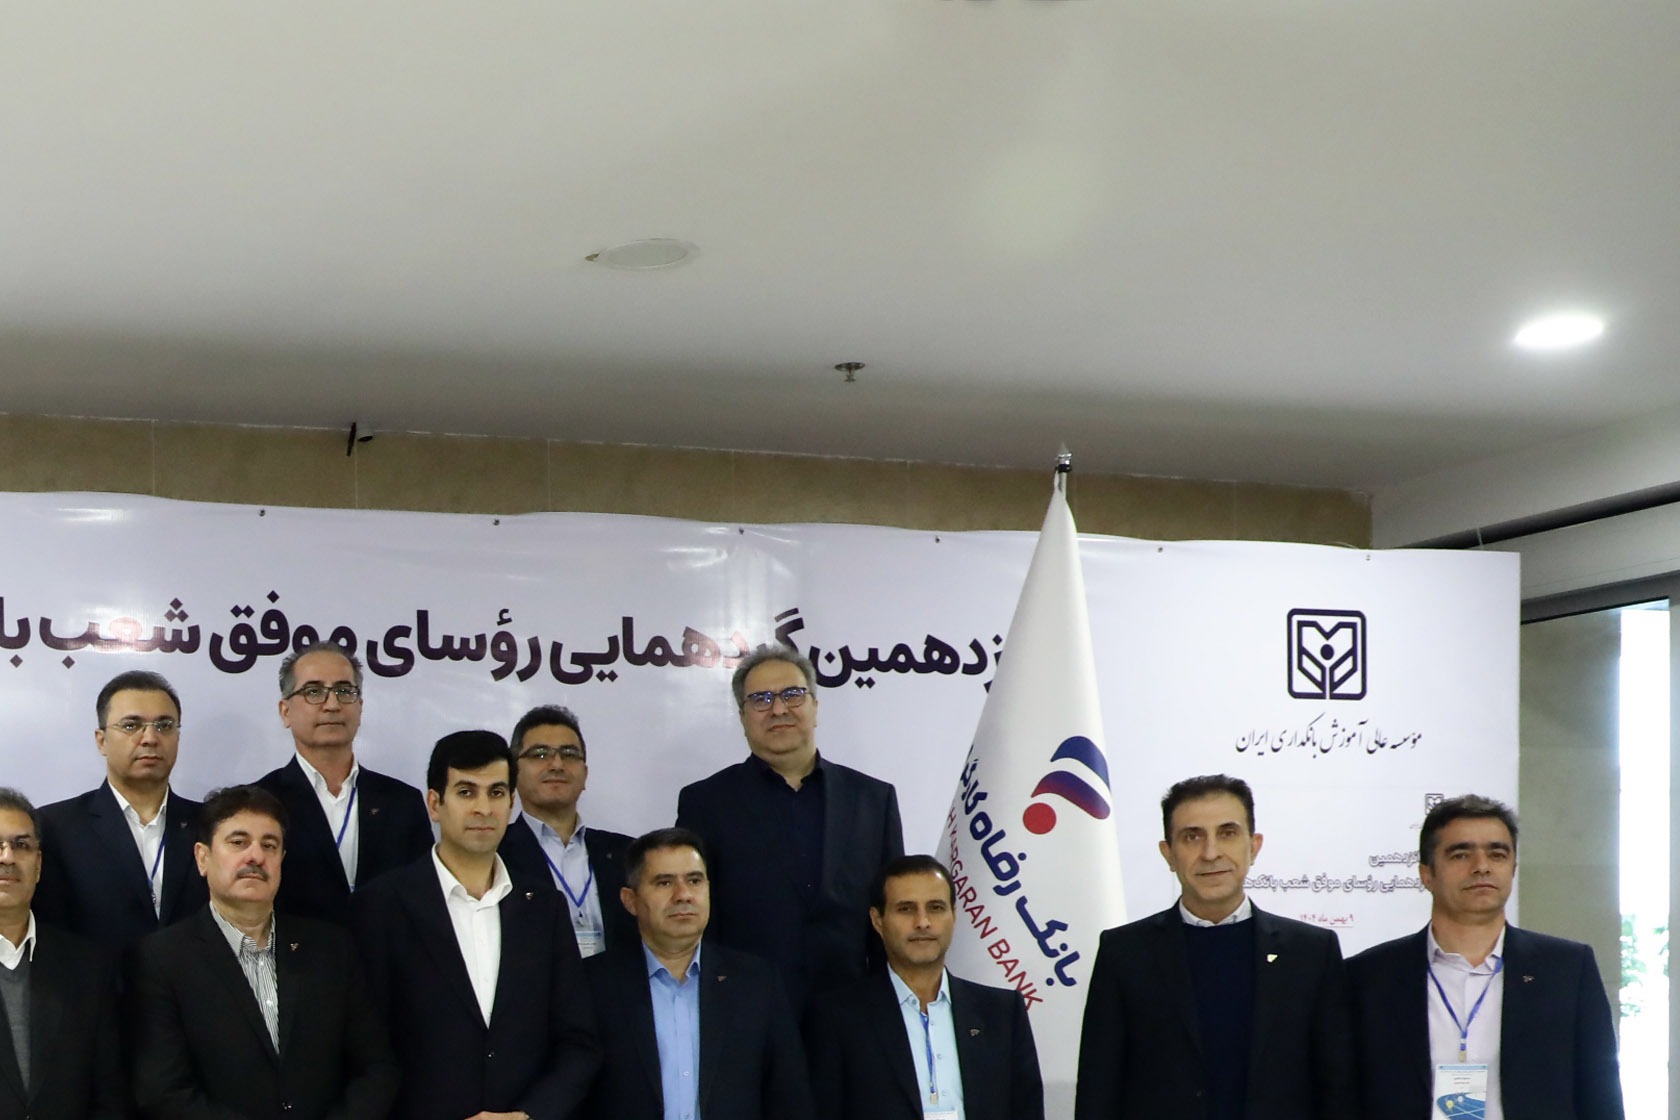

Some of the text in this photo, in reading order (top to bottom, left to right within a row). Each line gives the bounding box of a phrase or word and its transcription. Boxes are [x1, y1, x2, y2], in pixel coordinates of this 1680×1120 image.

[39, 597, 201, 669] شعب
[366, 608, 542, 682] رؤسای
[550, 607, 805, 686] گدهمایی
[809, 633, 1003, 694] زدهمین
[1236, 728, 1269, 756] ایران
[1320, 718, 1369, 754] آموزش
[1366, 727, 1388, 755] عالی
[970, 811, 1027, 896] رفاه
[988, 938, 1044, 1010] BANK
[1016, 895, 1081, 987] بانک
